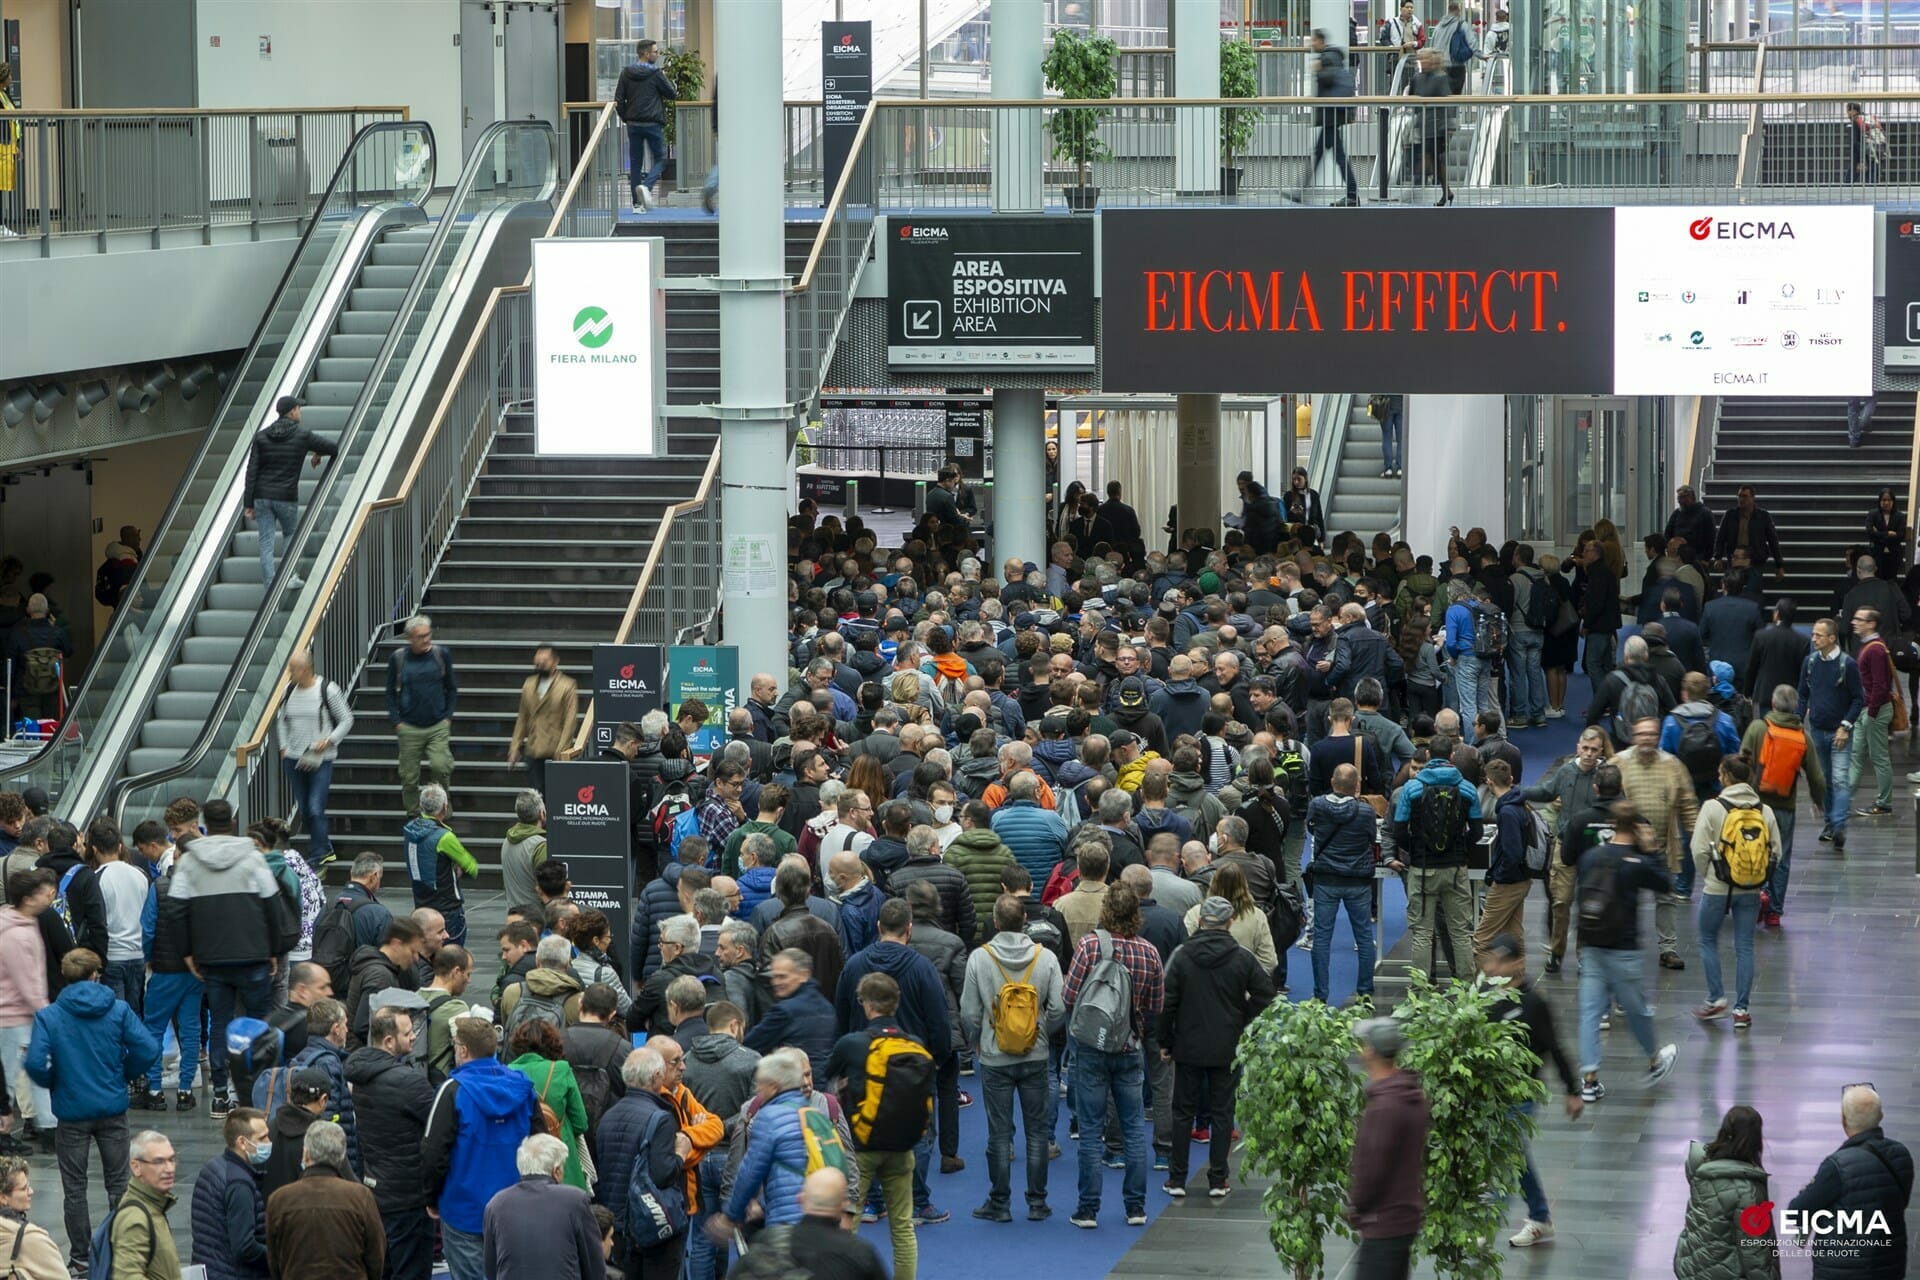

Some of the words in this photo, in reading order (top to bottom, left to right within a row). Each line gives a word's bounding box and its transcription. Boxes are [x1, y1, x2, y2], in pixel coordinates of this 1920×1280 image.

[833, 45, 861, 53] EICMA
[913, 227, 949, 237] EICMA
[1717, 222, 1795, 239] EICMA
[952, 260, 1004, 277] AREA
[953, 279, 1067, 295] ESPOSITIVA
[953, 297, 1051, 314] EXHIBITION
[1143, 270, 1325, 332] EICMA
[1340, 270, 1568, 332] EFFECT.
[952, 316, 997, 332] AREA
[550, 354, 586, 363] FIERA
[591, 354, 637, 363] MILANO
[1713, 372, 1769, 384] EICMA.IT
[609, 679, 647, 689] EICMA
[564, 804, 609, 816] EICMA
[575, 891, 609, 899] STAMPA
[640, 1193, 668, 1226] MAPEI
